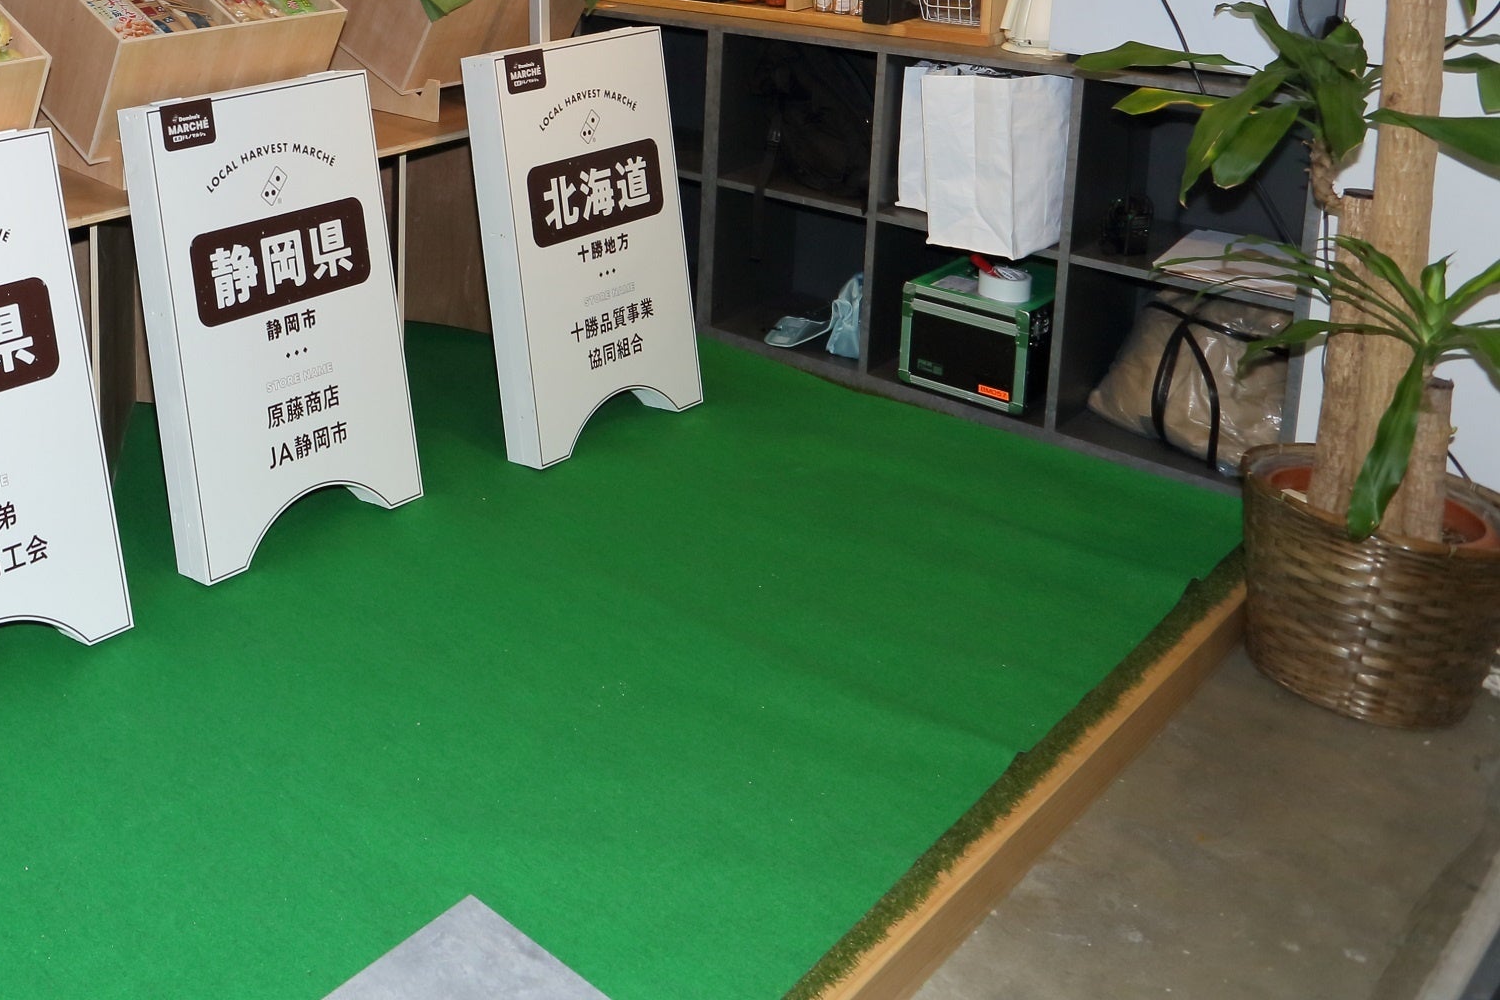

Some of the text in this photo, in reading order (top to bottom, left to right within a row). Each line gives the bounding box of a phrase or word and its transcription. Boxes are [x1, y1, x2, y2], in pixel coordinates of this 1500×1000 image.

[167, 116, 210, 136] MARCHÉ
[539, 89, 638, 132] LOCAL HARVEST MARCHÉ
[206, 142, 337, 194] LOCAL HARVEST MARCHÉ
[543, 155, 651, 231] 北海道
[209, 218, 355, 310] 静岡県
[577, 232, 630, 264] 十勝地方
[265, 308, 317, 342] 静岡市
[570, 297, 654, 343] 十勝品質事業
[588, 332, 644, 370] 協同組合
[266, 384, 340, 430] 原藤商店
[269, 421, 348, 470] JA静岡市
